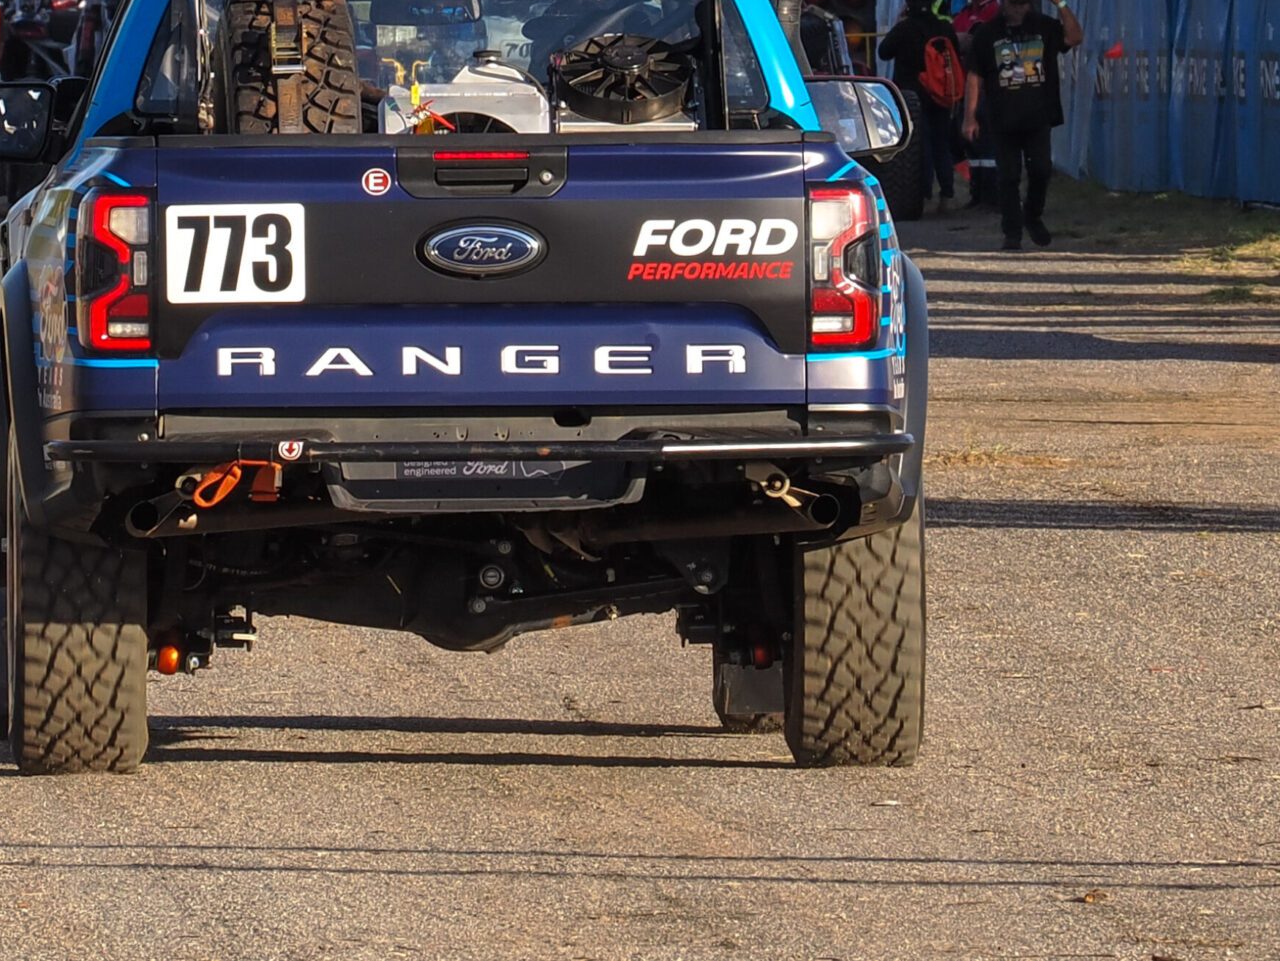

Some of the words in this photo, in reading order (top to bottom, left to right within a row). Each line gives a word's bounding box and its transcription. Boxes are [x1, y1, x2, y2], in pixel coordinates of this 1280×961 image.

[453, 235, 513, 262] Ford
[632, 218, 799, 257] FORD
[177, 213, 294, 293] 773
[627, 261, 795, 281] PERFORMANCE
[216, 344, 747, 377] RANGER
[403, 466, 457, 477] engineered
[462, 460, 509, 475] Ford
